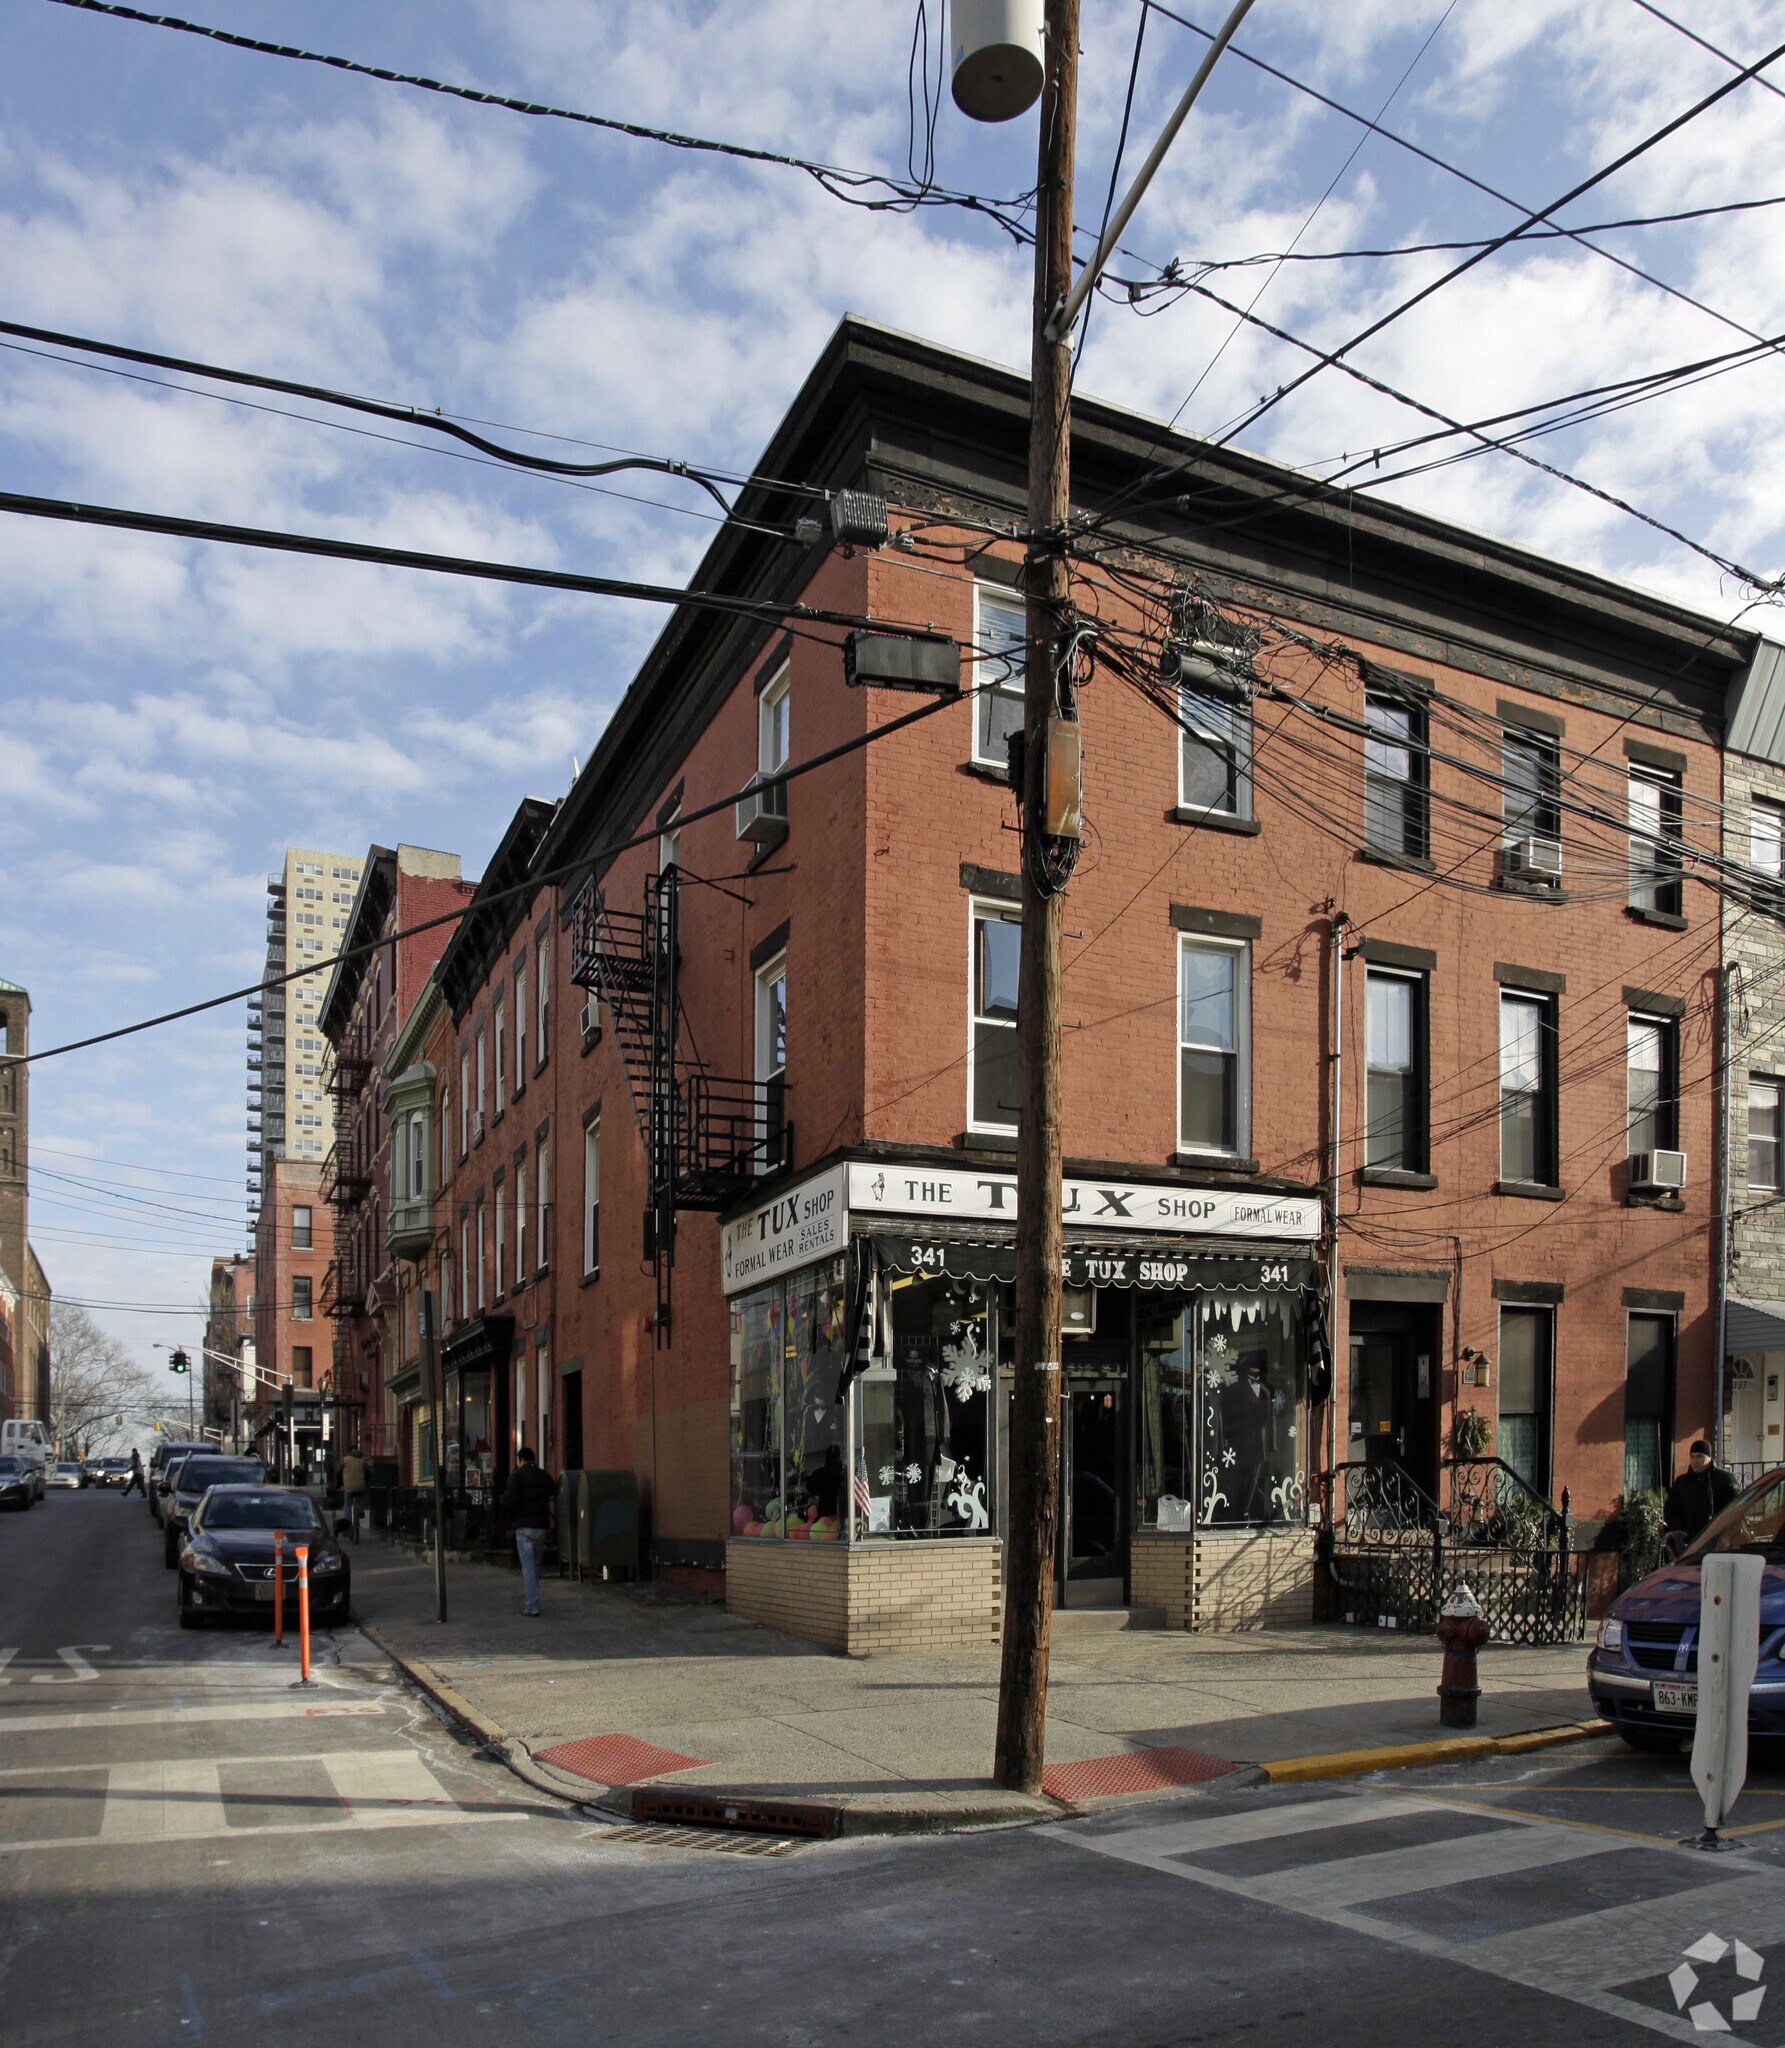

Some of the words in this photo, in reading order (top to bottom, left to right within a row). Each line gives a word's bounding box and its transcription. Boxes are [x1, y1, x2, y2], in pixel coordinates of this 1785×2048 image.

[904, 1180, 952, 1203] THE
[1157, 1197, 1216, 1219] SHOP
[736, 1220, 753, 1242] THE
[757, 1193, 801, 1241] TUX
[804, 1189, 835, 1219] SHOP
[1234, 1206, 1273, 1223] FORMAL
[1275, 1208, 1303, 1226] WEAR
[800, 1219, 829, 1239] SALES
[799, 1230, 835, 1254] RENTALS
[735, 1252, 767, 1279] FORMAL
[768, 1239, 794, 1267] WEAR
[910, 1245, 945, 1267] 341
[1085, 1259, 1126, 1279] TUX
[1139, 1263, 1188, 1282] SHOP
[1260, 1265, 1289, 1283] 341
